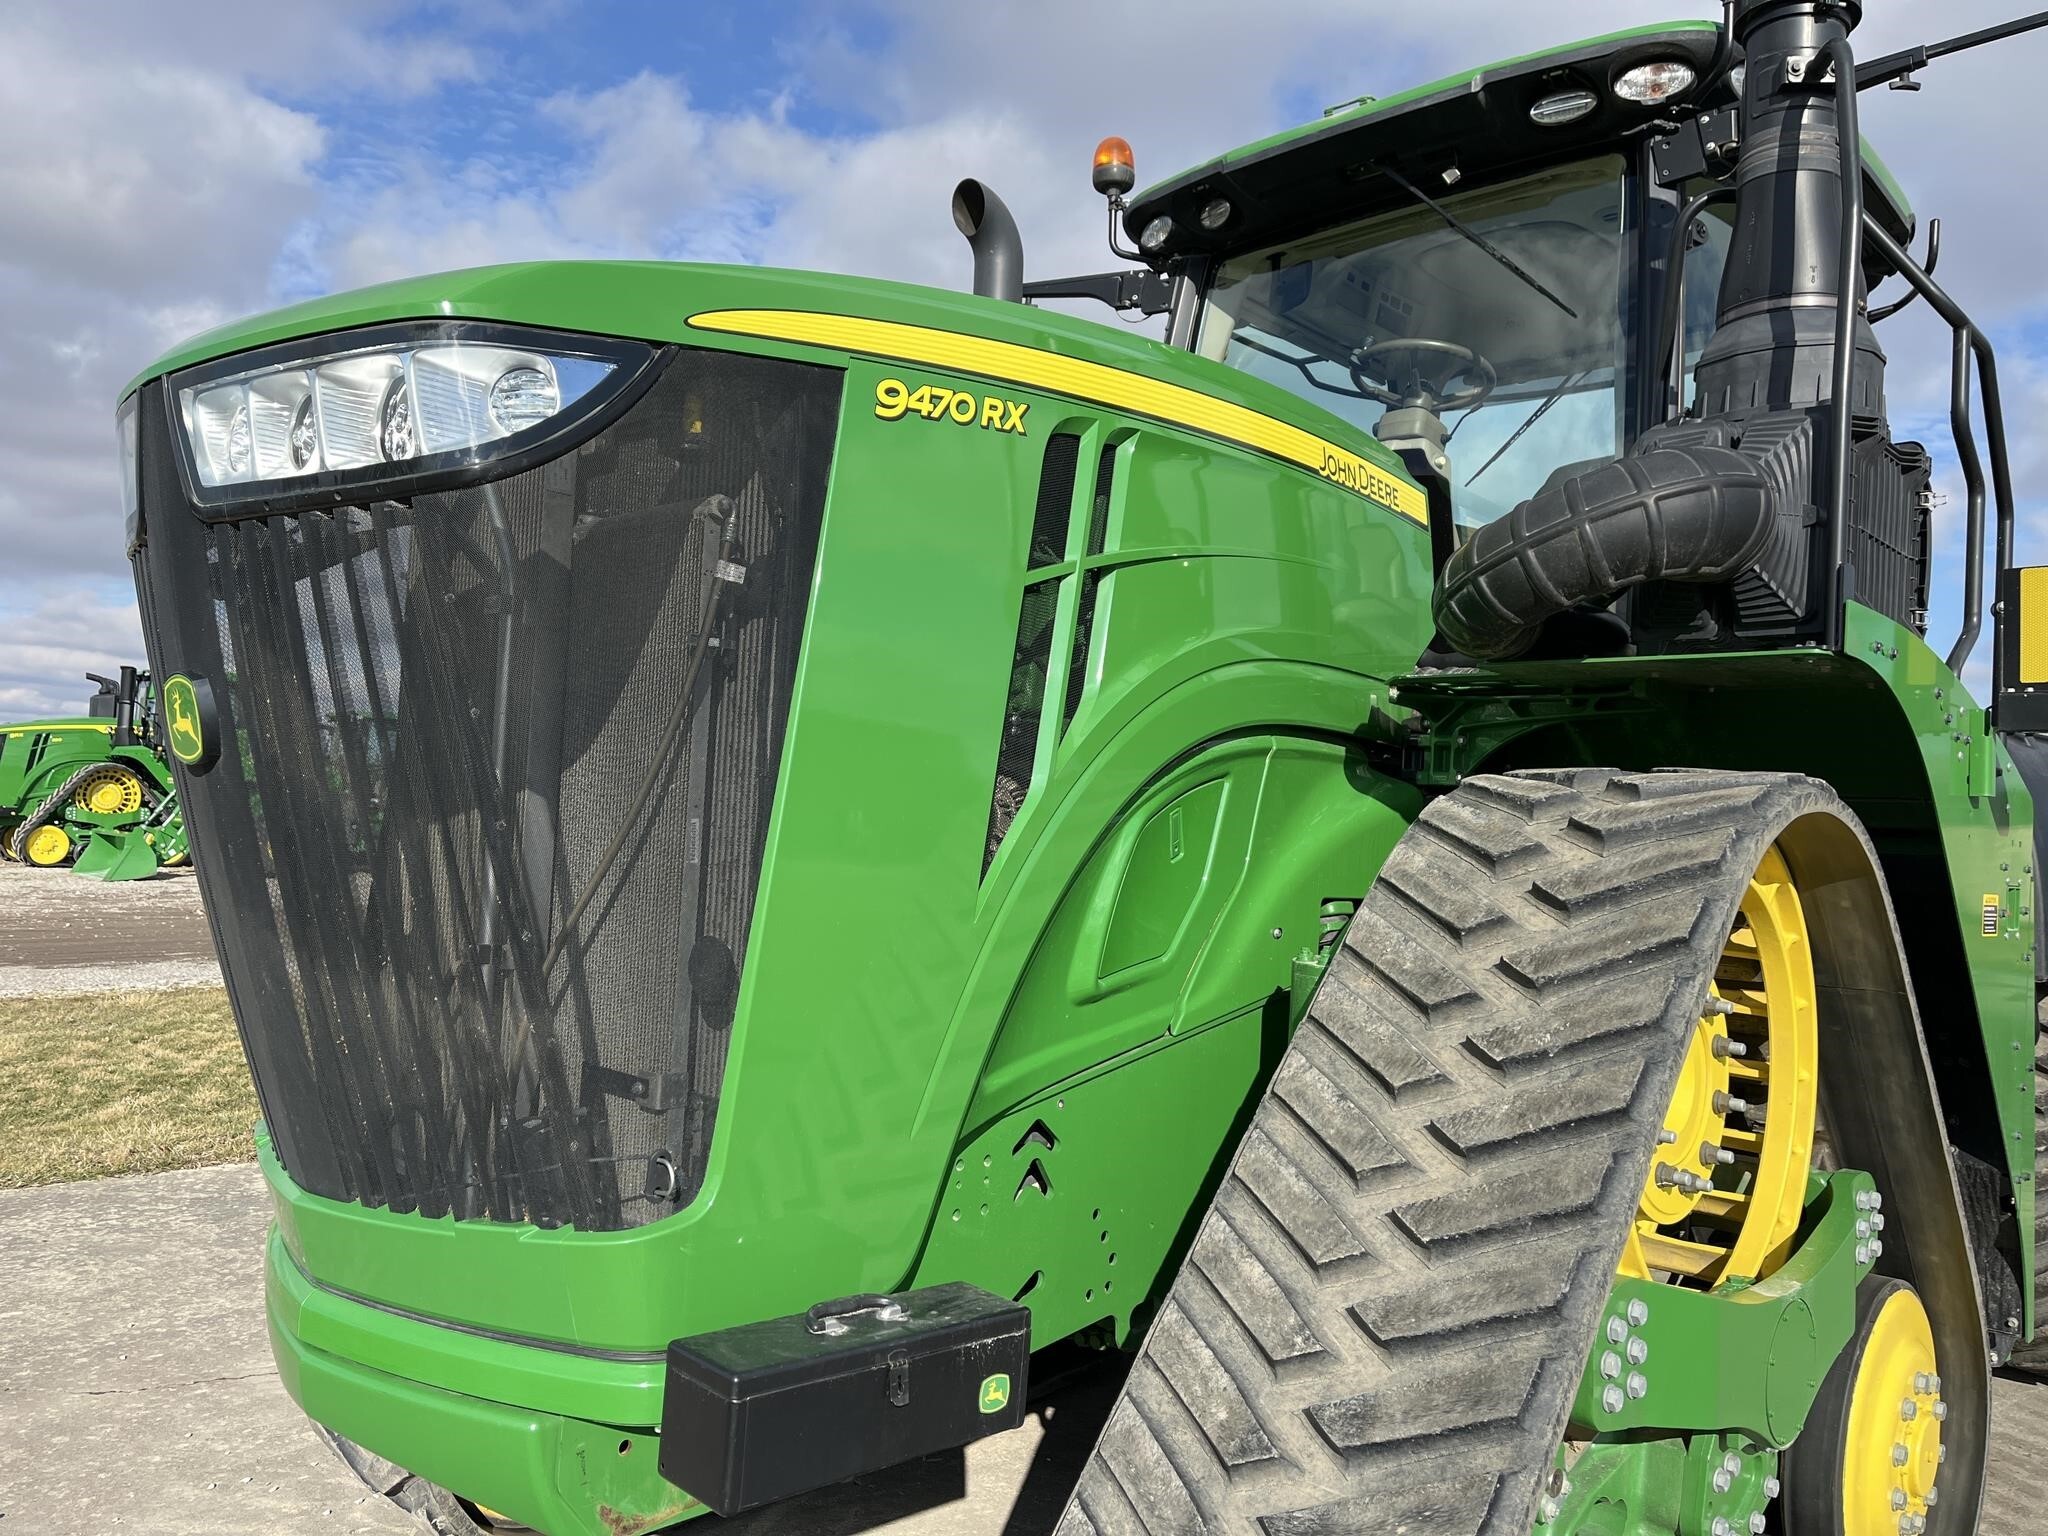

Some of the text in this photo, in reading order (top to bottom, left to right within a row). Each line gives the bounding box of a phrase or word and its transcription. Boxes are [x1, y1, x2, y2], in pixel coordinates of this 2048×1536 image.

[875, 378, 1030, 436] 9470 RX
[1319, 446, 1400, 508] JOHN DEERE
